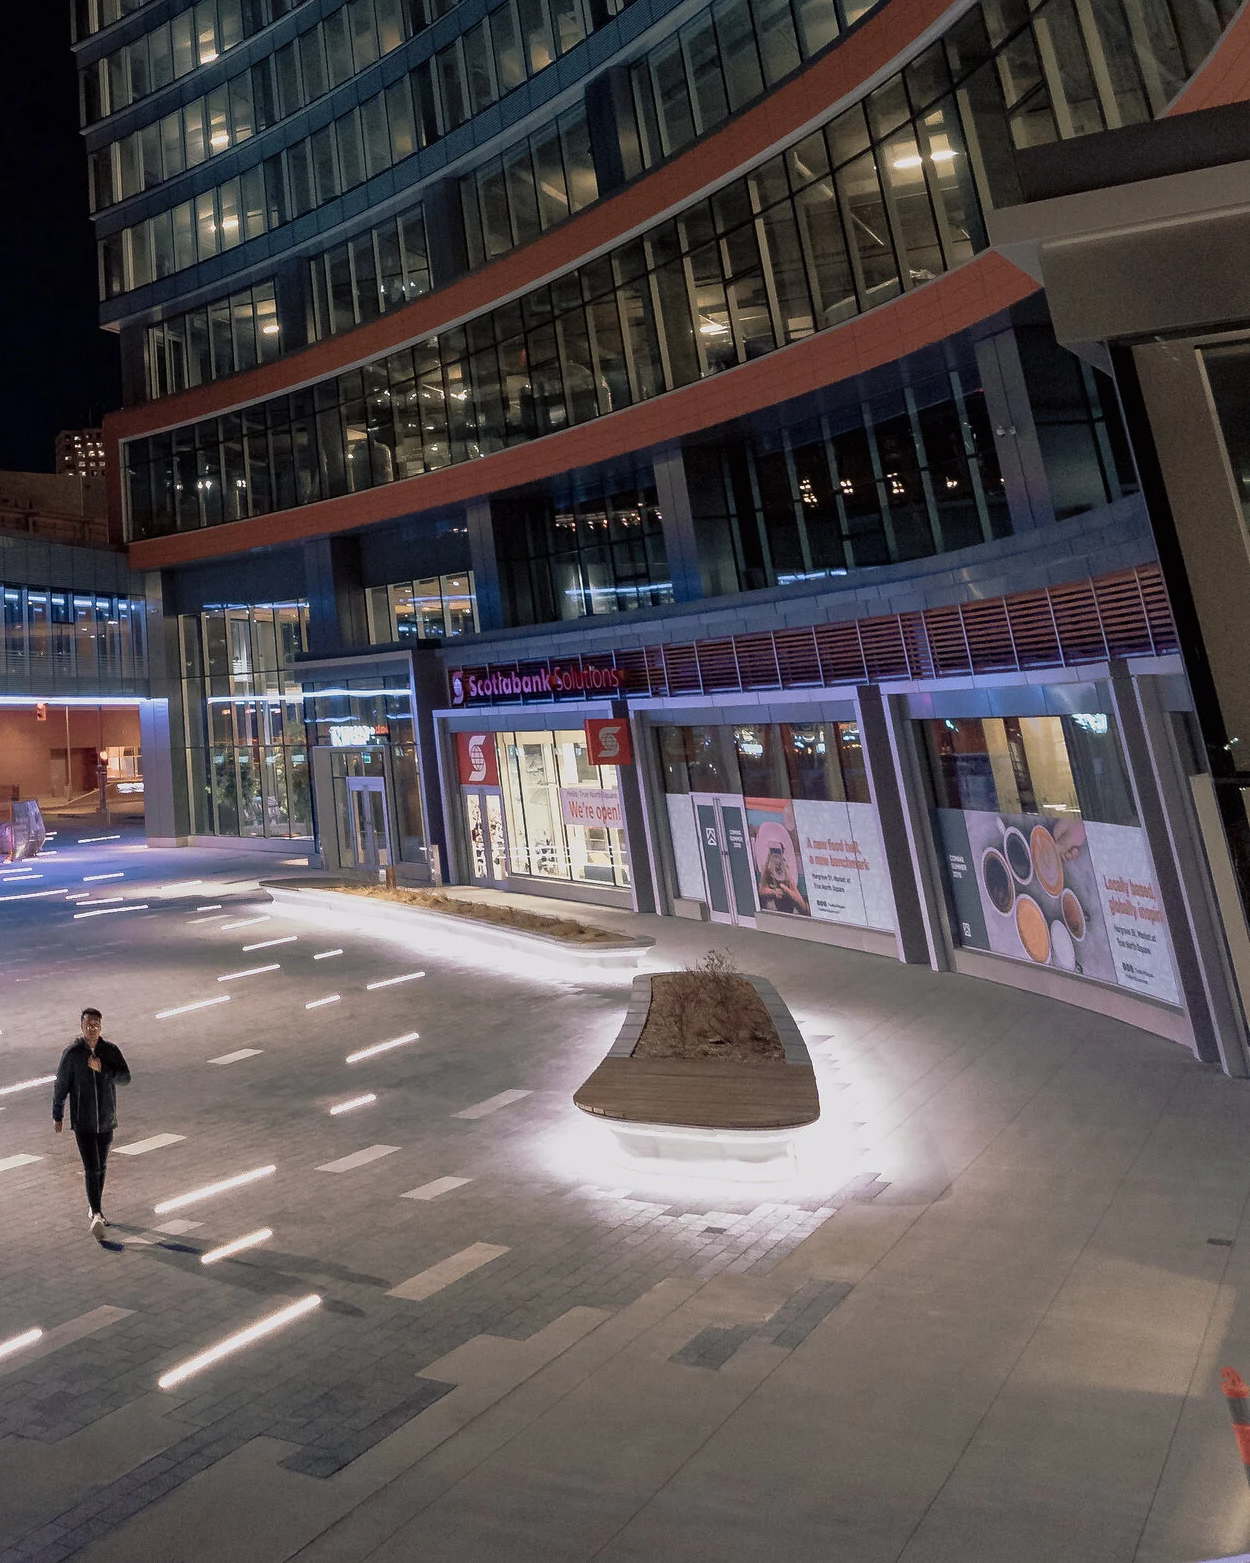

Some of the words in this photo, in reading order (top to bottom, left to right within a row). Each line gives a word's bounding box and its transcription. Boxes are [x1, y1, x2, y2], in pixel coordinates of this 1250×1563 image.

[469, 668, 550, 697] Scotiabank
[553, 663, 619, 691] Solutions
[569, 801, 594, 819] We're
[596, 803, 622, 824] open!
